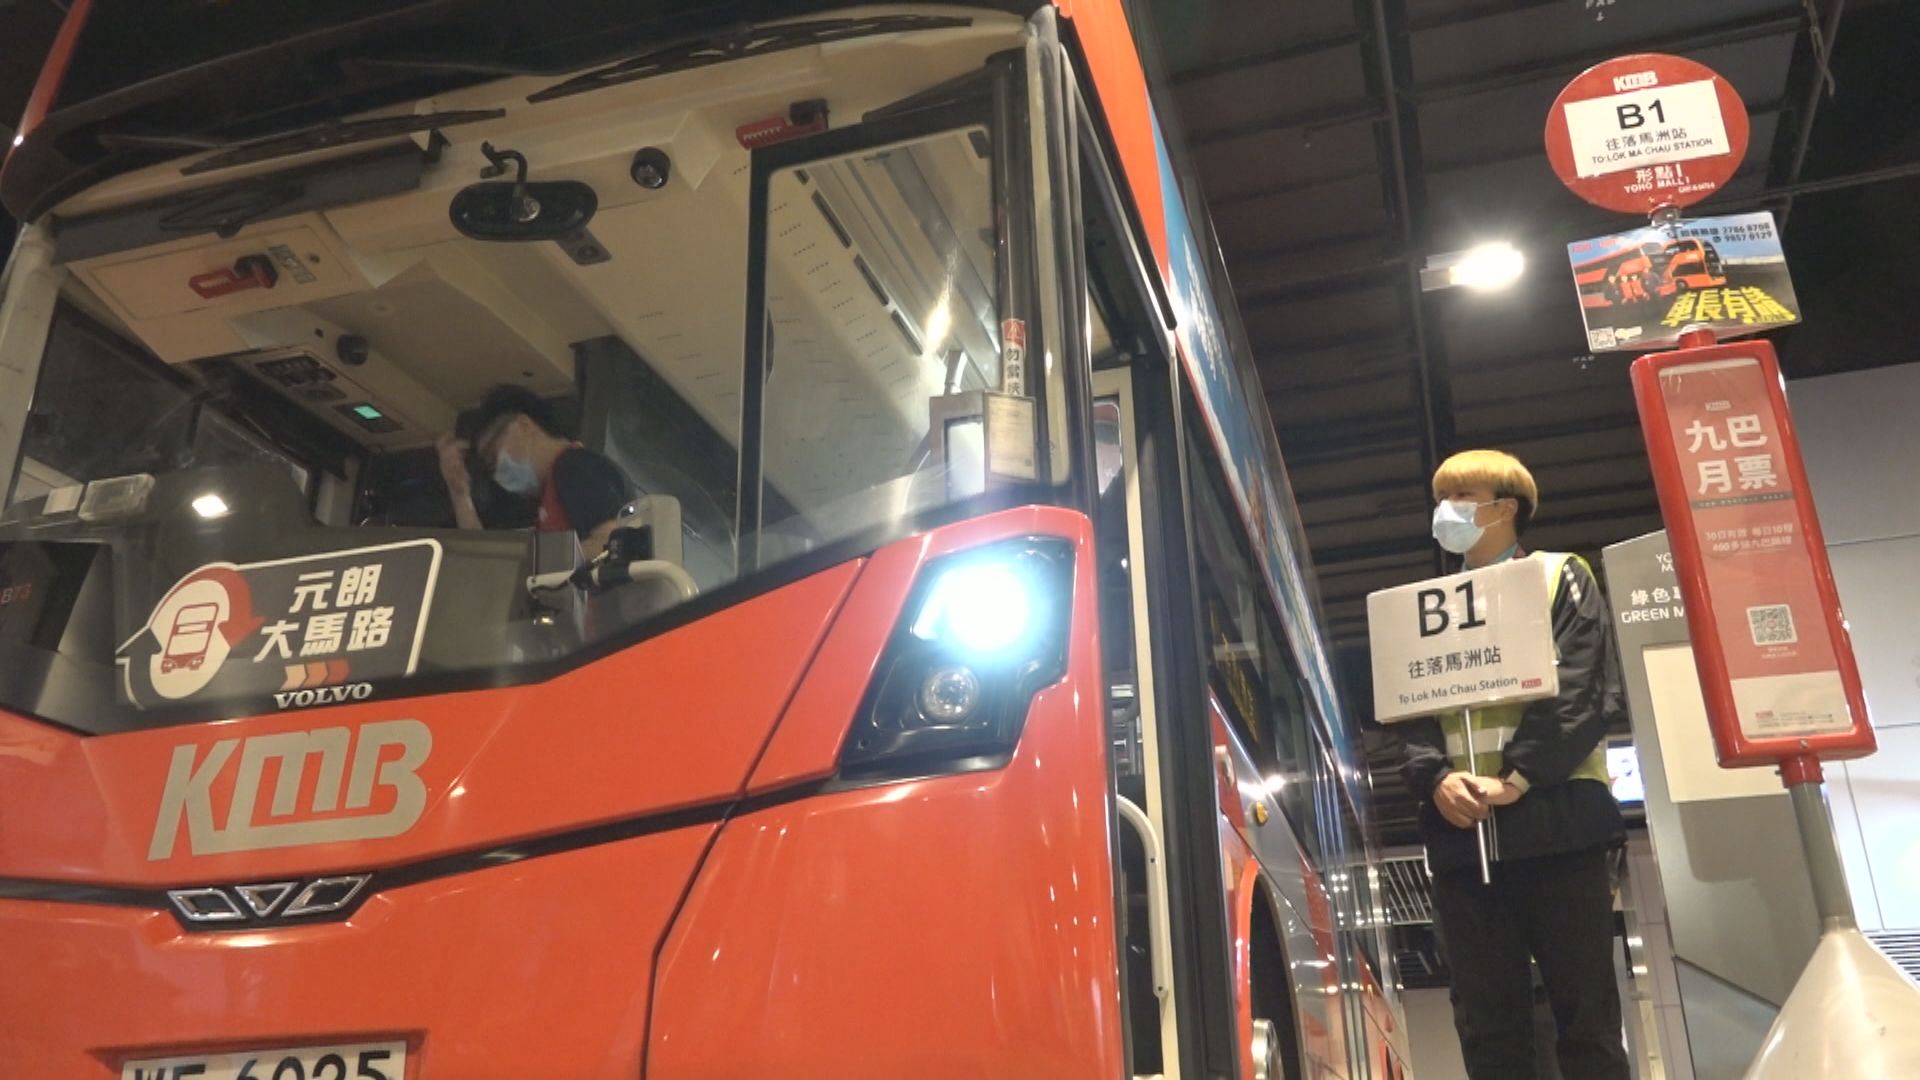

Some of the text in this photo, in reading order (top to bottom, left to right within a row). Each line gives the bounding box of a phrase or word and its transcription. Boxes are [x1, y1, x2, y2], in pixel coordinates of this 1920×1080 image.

[1613, 71, 1658, 92] KMB
[1616, 99, 1666, 130] B1
[1605, 128, 1687, 151] 往落馬洲站
[1606, 152, 1626, 162] LOK
[1628, 150, 1643, 158] MA
[1645, 145, 1671, 156] CHAU
[1674, 138, 1713, 151] STATION
[1624, 183, 1653, 193] YOHO
[1657, 178, 1683, 189] MALL
[1685, 414, 1768, 454] 九巴
[1698, 454, 1777, 495] 月票
[288, 564, 382, 613] 元朗
[1417, 579, 1486, 638] B1
[1621, 607, 1669, 623] GREEN
[253, 606, 395, 663] 大馬路
[1407, 645, 1502, 680] 往落馬洲站
[273, 682, 373, 709] VOLVO
[1399, 694, 1410, 705] To
[1411, 689, 1429, 703] Lok
[1431, 686, 1448, 699] Ma
[1450, 682, 1477, 696] Chau
[1479, 675, 1518, 691] Station
[147, 718, 433, 861] KMB
